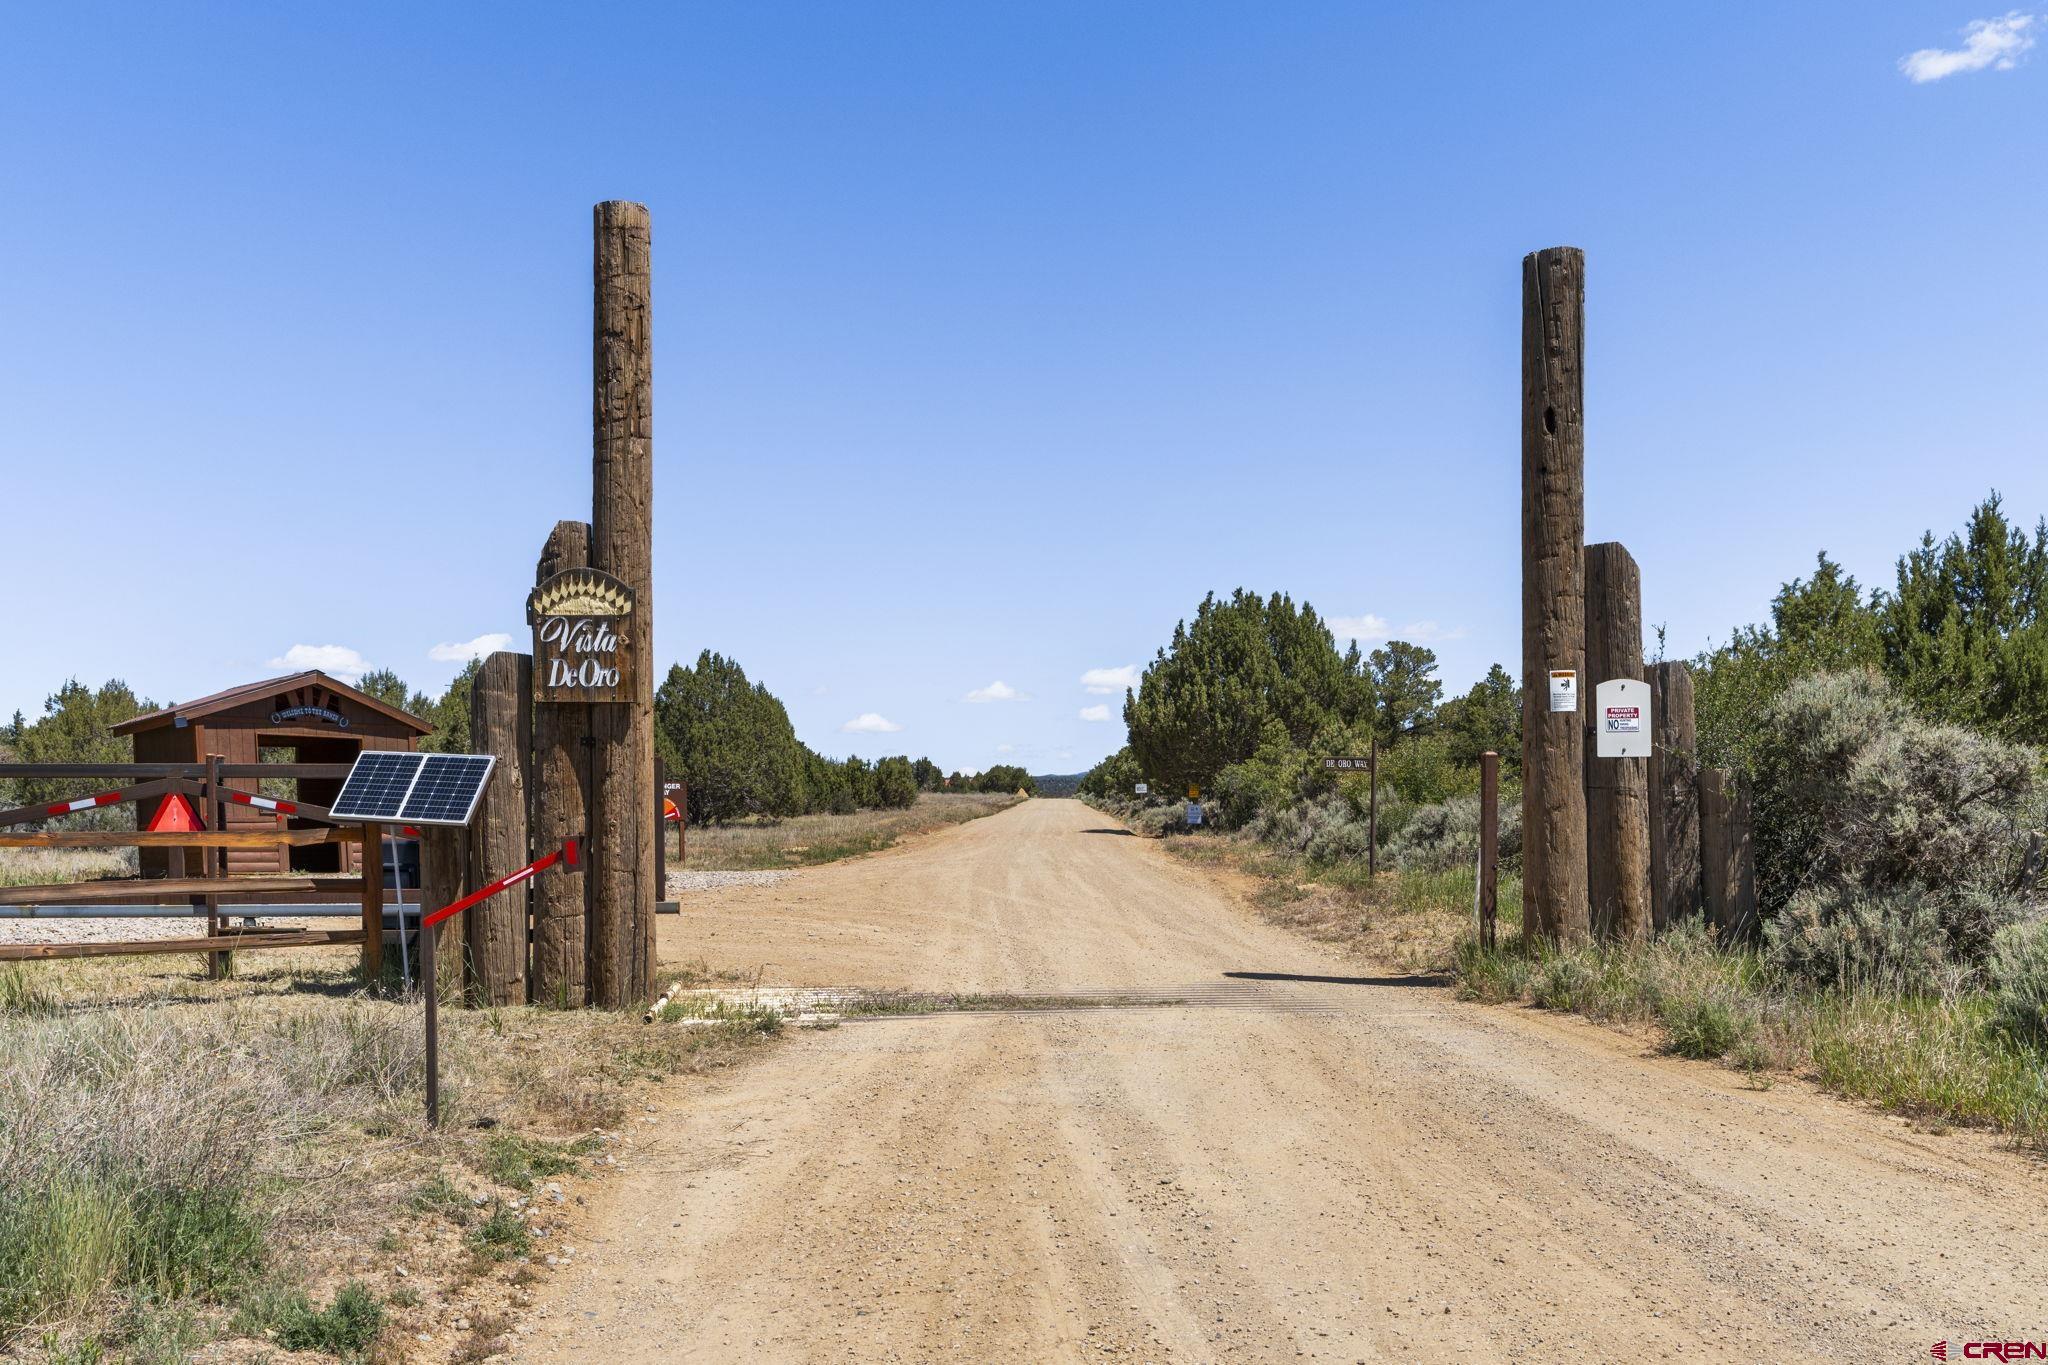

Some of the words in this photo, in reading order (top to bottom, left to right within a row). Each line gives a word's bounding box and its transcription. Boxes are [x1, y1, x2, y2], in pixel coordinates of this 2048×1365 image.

[540, 616, 618, 653] Vista
[548, 658, 578, 688] De
[578, 658, 620, 688] Oro
[1608, 719, 1620, 730] NO
[1325, 760, 1335, 768] DE
[1337, 760, 1352, 768] ORO
[1354, 760, 1368, 768] WAY
